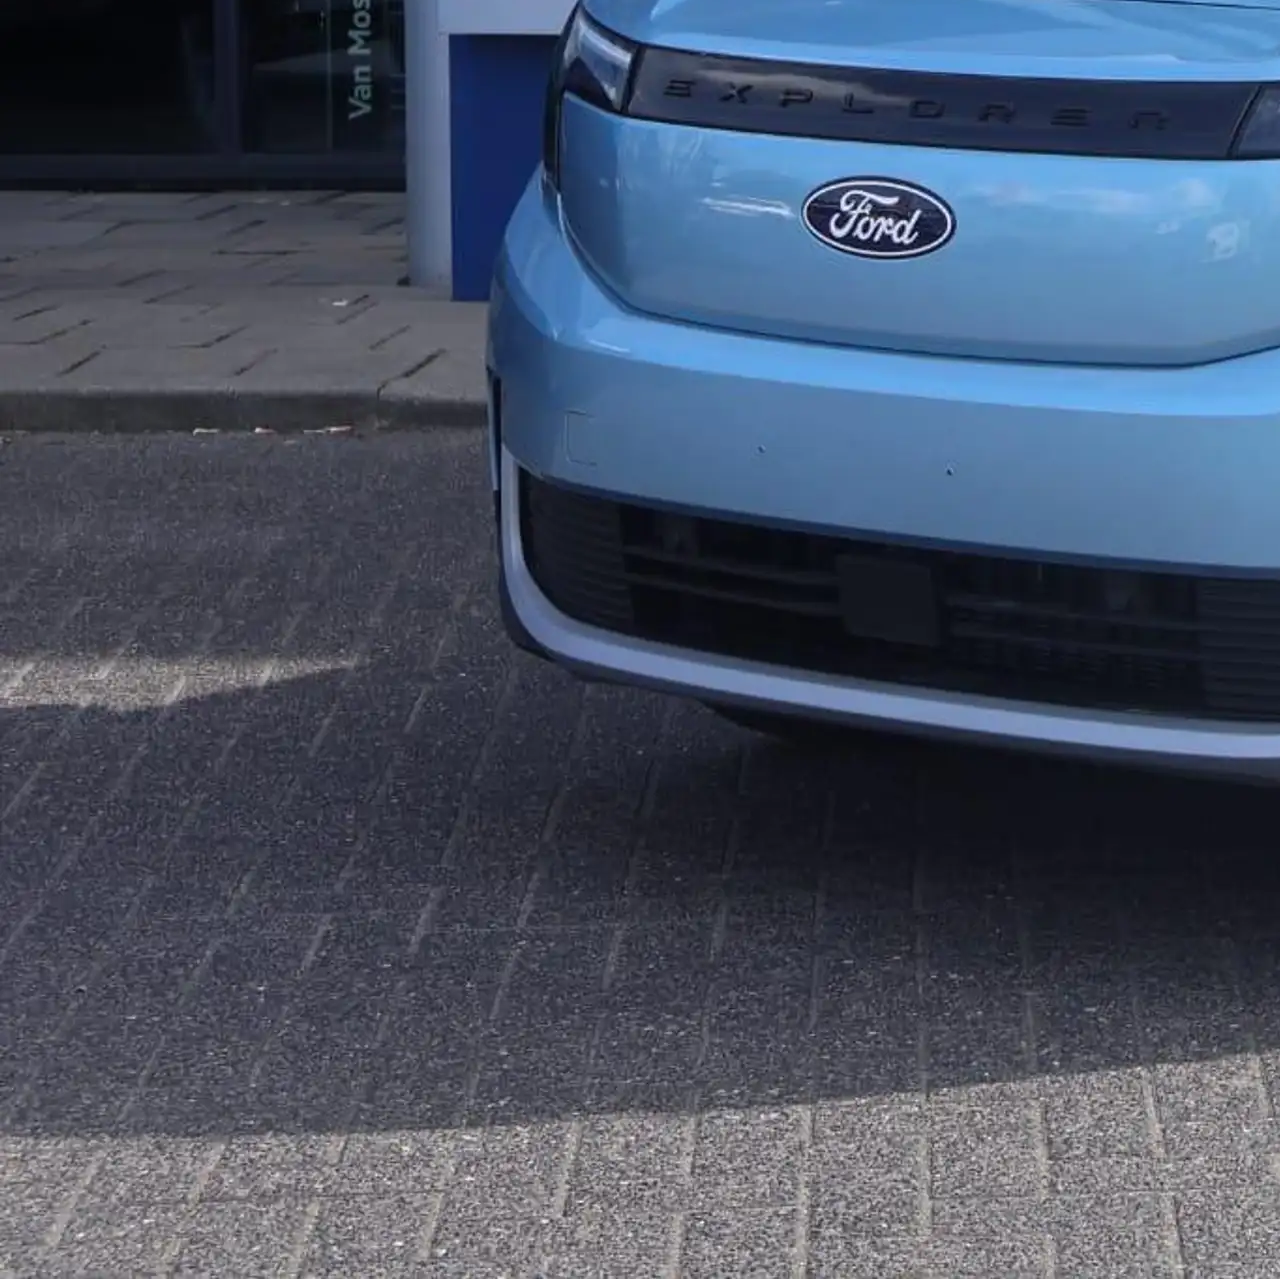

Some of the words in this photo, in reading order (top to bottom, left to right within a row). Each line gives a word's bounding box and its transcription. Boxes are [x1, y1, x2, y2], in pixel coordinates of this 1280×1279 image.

[346, 63, 373, 120] Van
[662, 78, 1171, 131] EXPLORER
[829, 189, 922, 246] Ford
